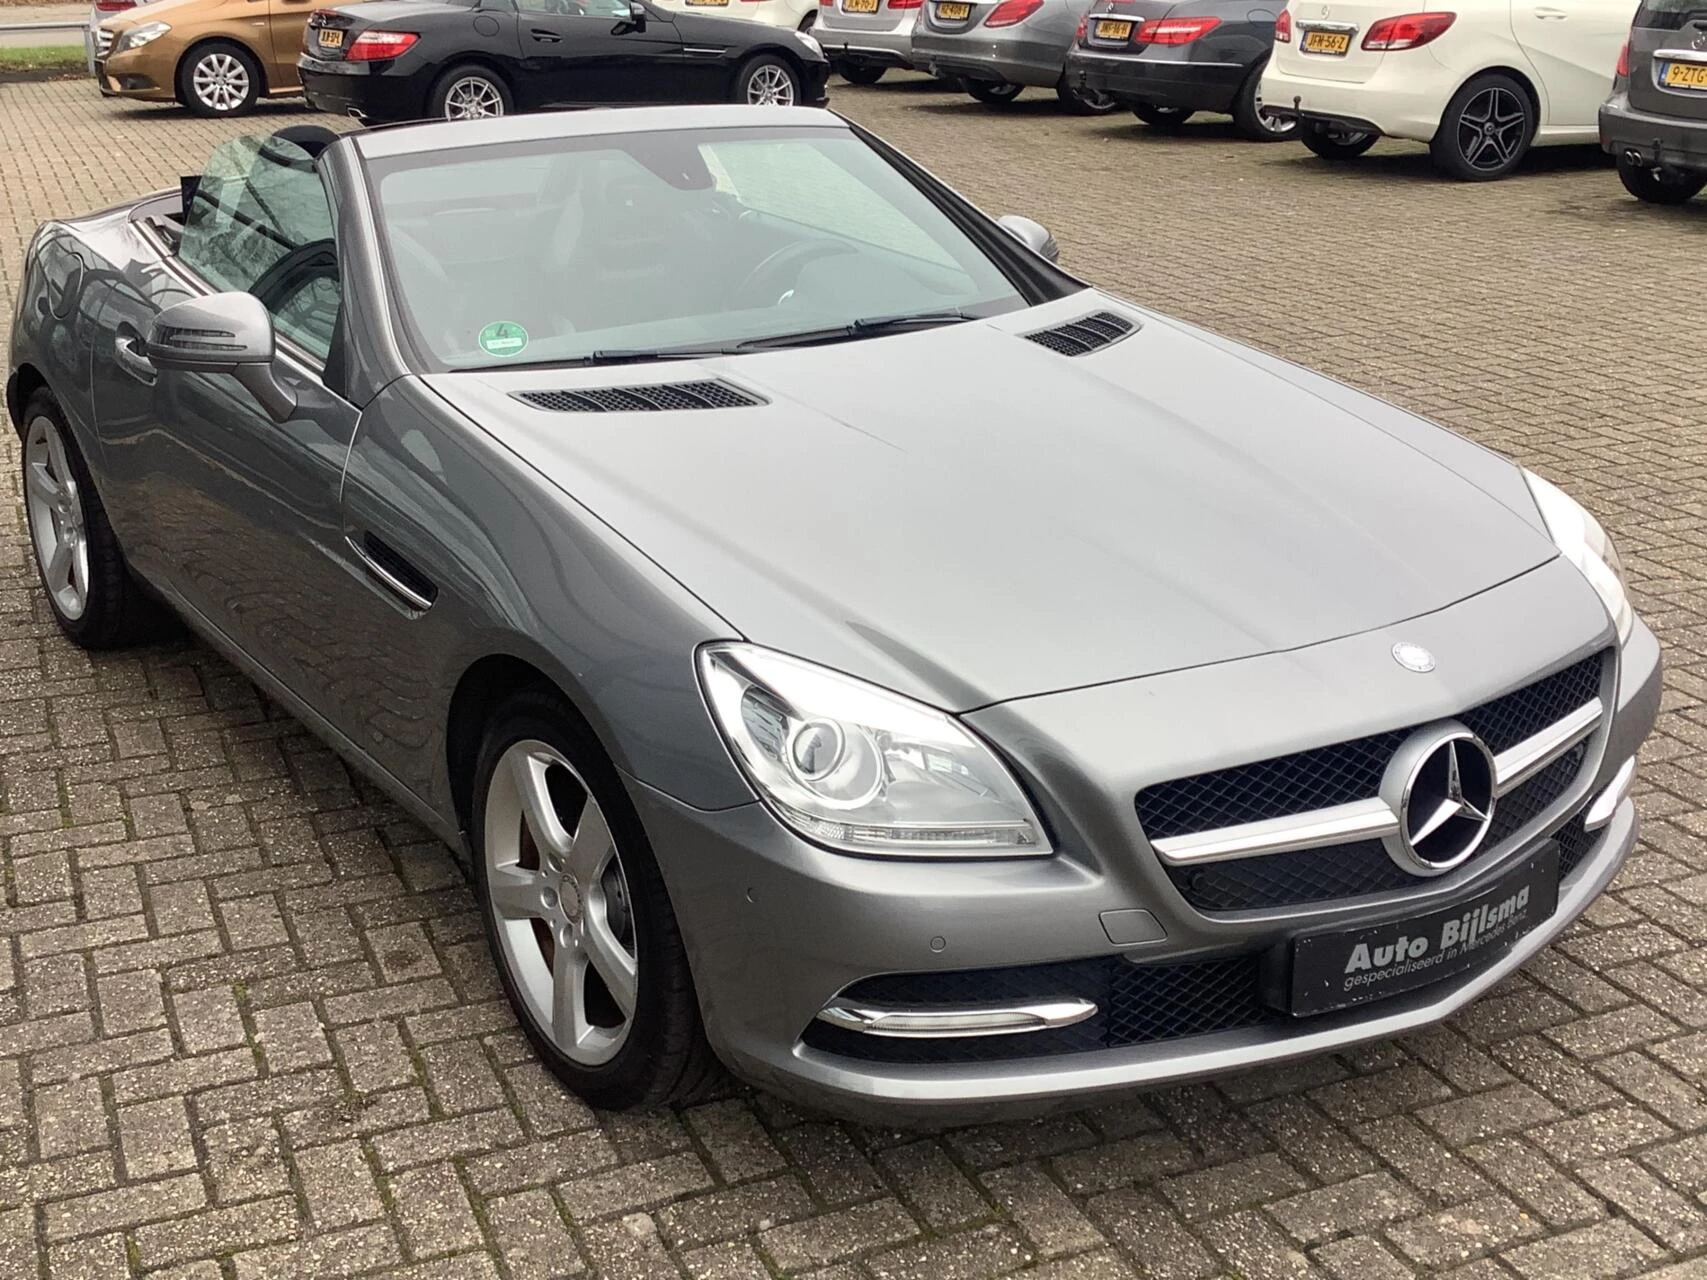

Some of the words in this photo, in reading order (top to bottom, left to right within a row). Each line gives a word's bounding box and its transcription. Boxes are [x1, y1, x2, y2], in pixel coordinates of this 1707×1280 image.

[1344, 935, 1429, 973] Auto
[1440, 885, 1530, 950] Bijlsma
[1343, 948, 1445, 991] gespecialiseerd
[1446, 945, 1458, 960] in
